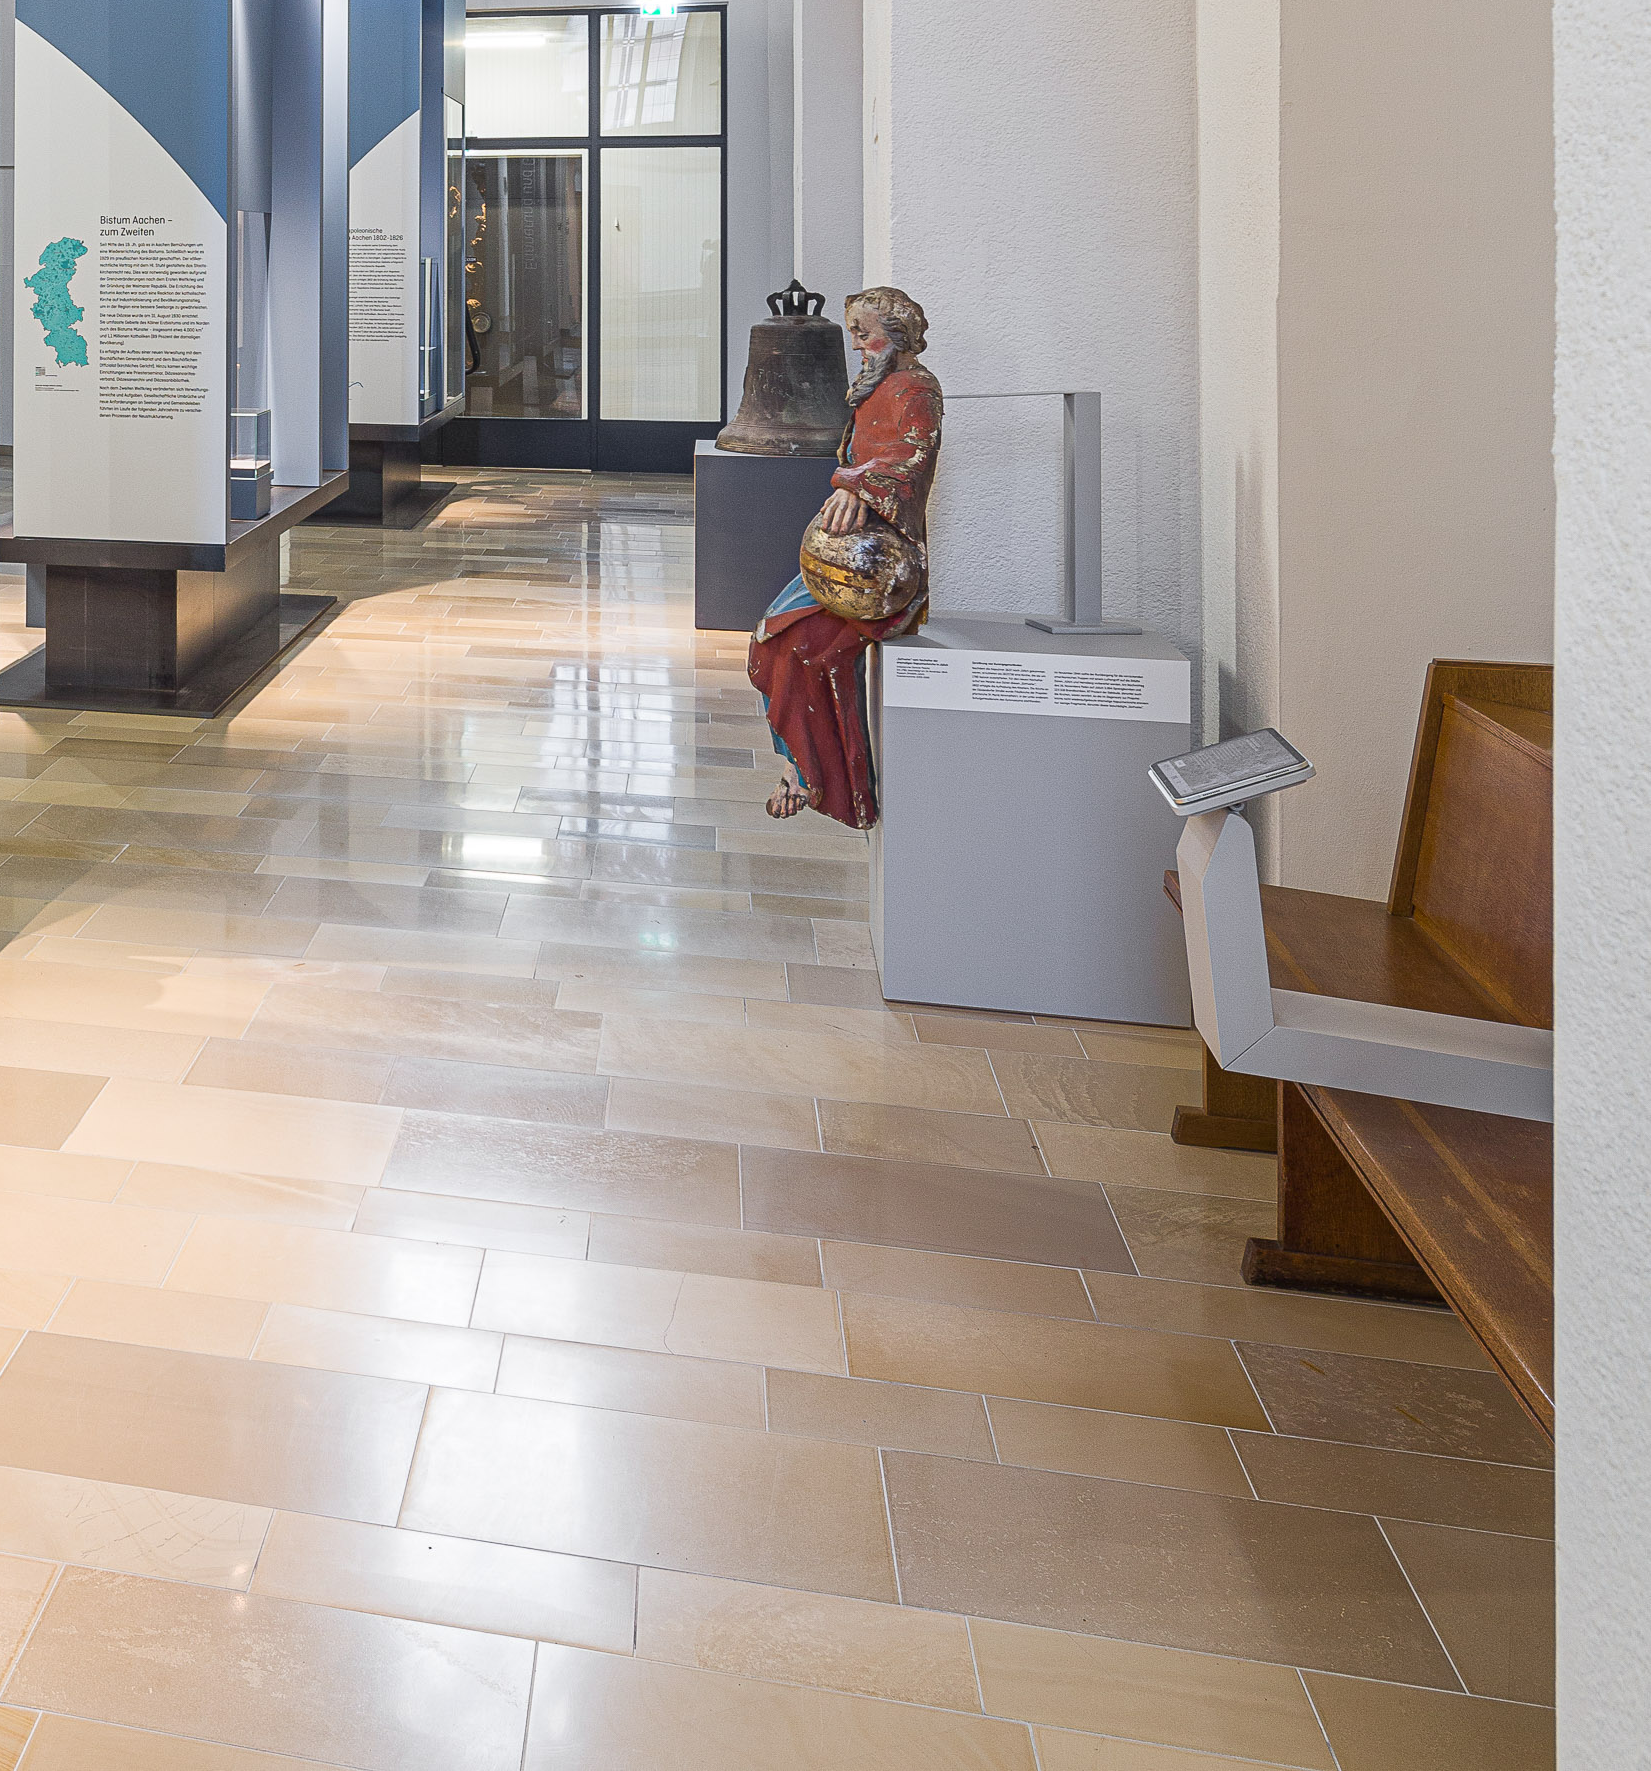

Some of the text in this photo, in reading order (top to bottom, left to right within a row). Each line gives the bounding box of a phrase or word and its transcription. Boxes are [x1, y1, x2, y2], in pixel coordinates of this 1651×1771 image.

[100, 215, 130, 224] Bistum
[132, 216, 165, 224] Aachen
[121, 227, 154, 236] Zweiten
